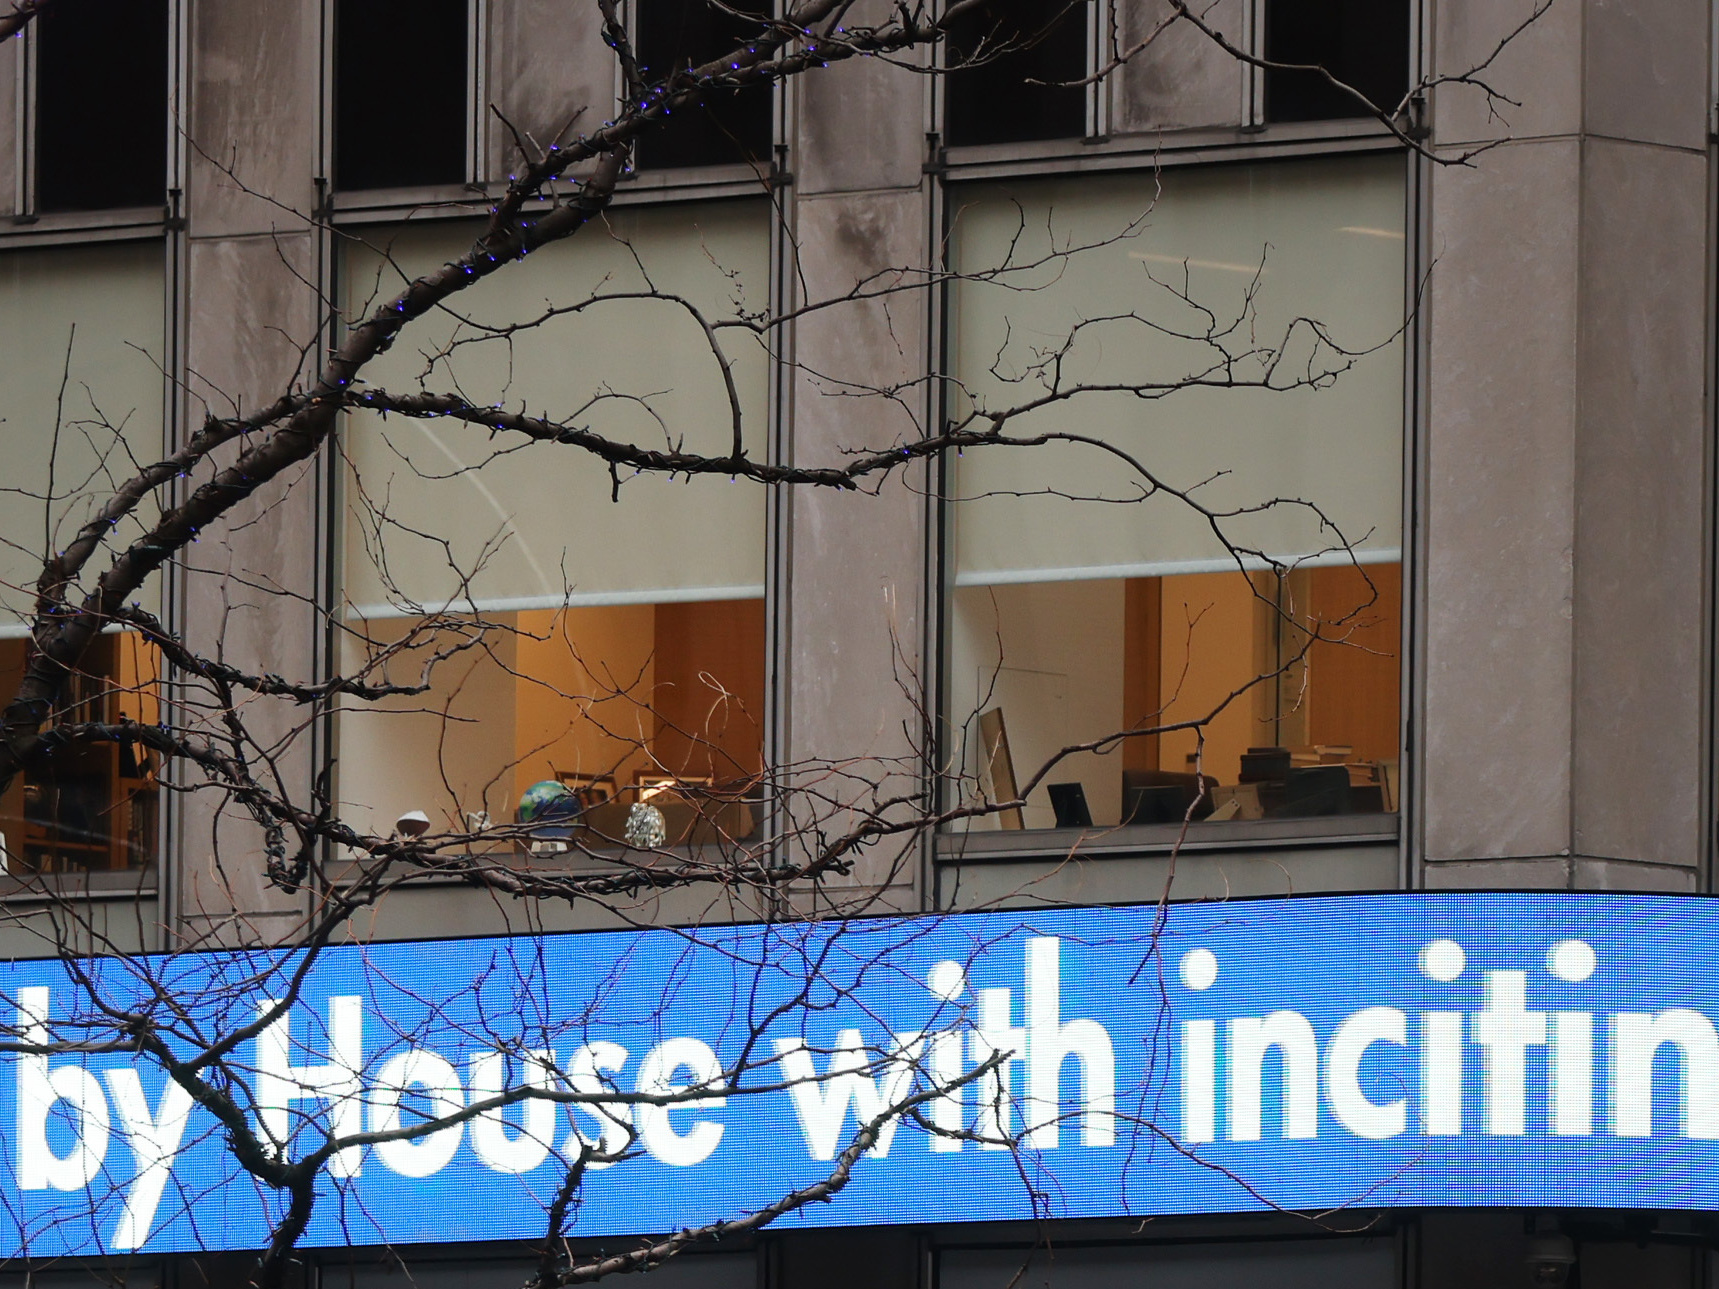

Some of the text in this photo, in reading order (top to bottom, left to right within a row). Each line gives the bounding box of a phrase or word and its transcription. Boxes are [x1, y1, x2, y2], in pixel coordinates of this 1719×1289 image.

[18, 987, 203, 1249] by
[257, 995, 727, 1177] House
[774, 937, 1115, 1160] with
